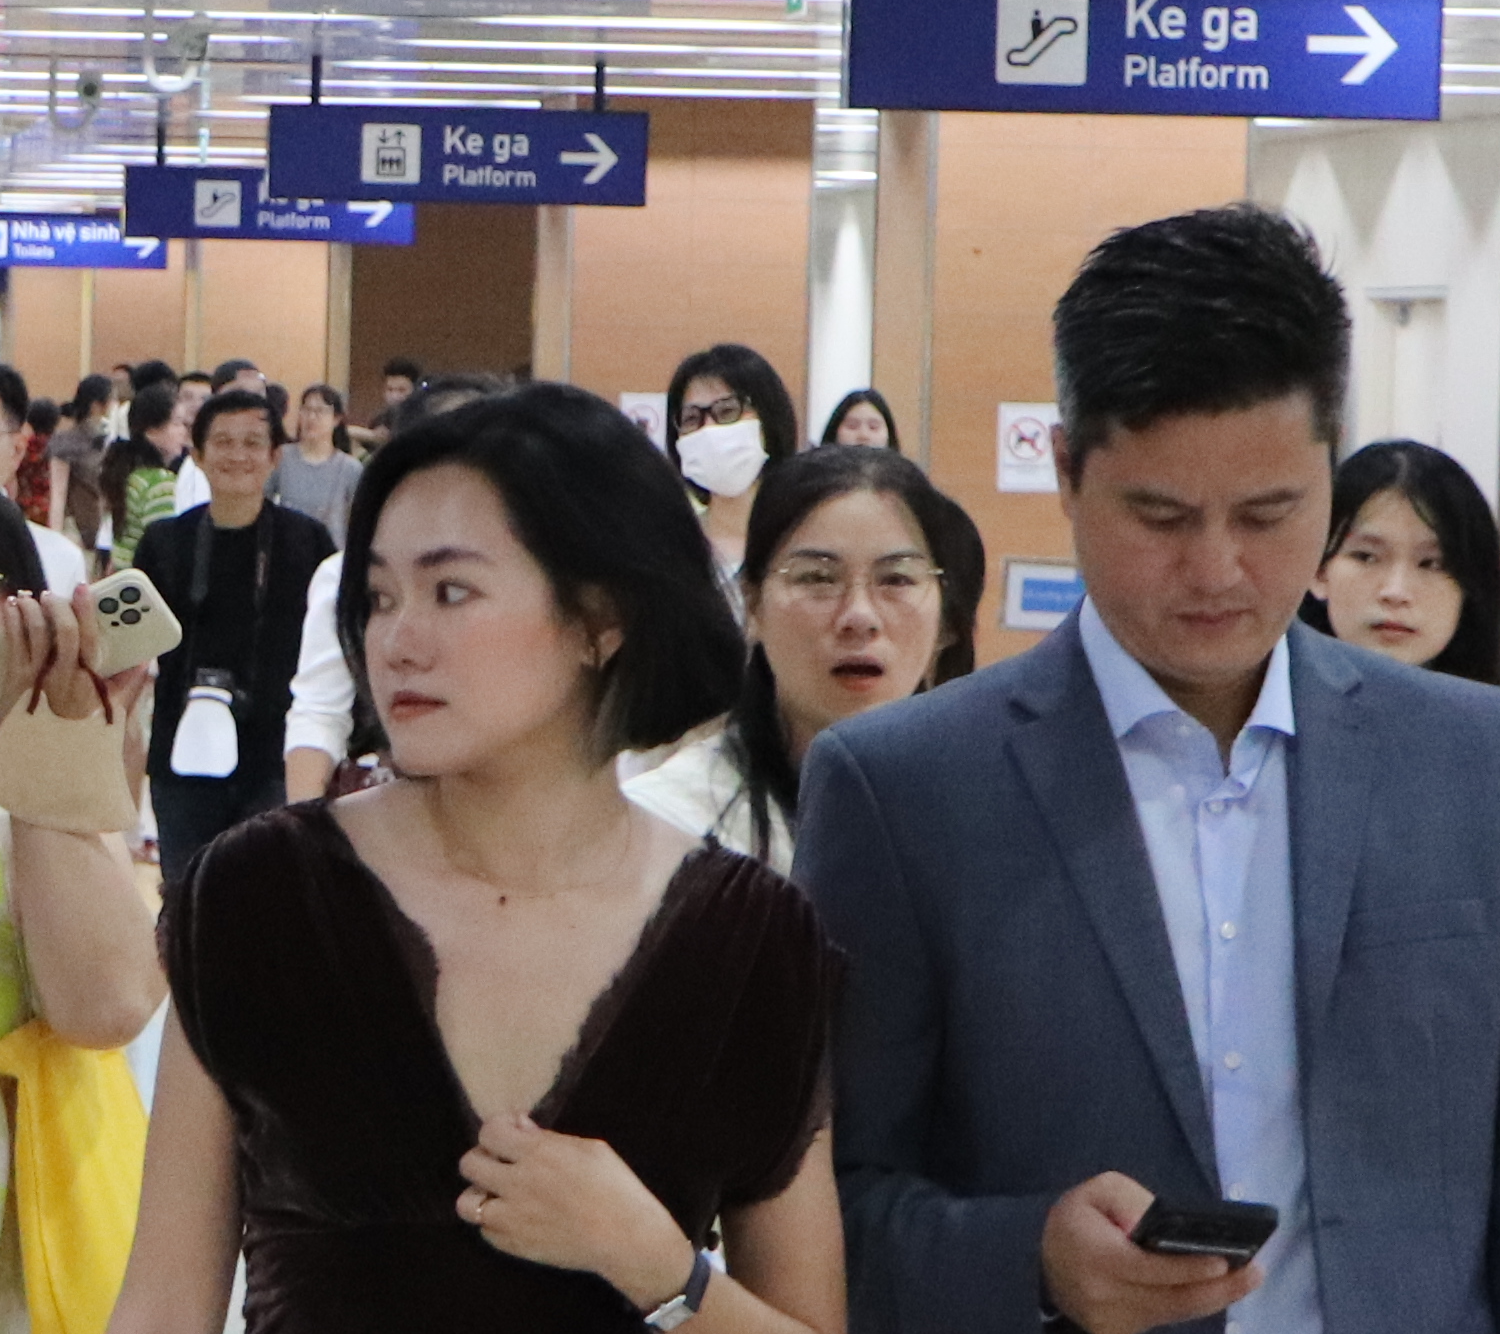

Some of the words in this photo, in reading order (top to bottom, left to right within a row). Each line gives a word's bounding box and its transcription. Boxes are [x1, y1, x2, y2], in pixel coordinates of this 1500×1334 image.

[1203, 7, 1258, 52] ga
[1125, 55, 1269, 90] Platform
[444, 126, 484, 155] Ke
[493, 134, 529, 163] ga
[444, 164, 536, 186] Platform
[11, 220, 51, 241] Nhà
[53, 221, 76, 244] vệ
[79, 222, 120, 242] sinh
[257, 210, 330, 229] Platform
